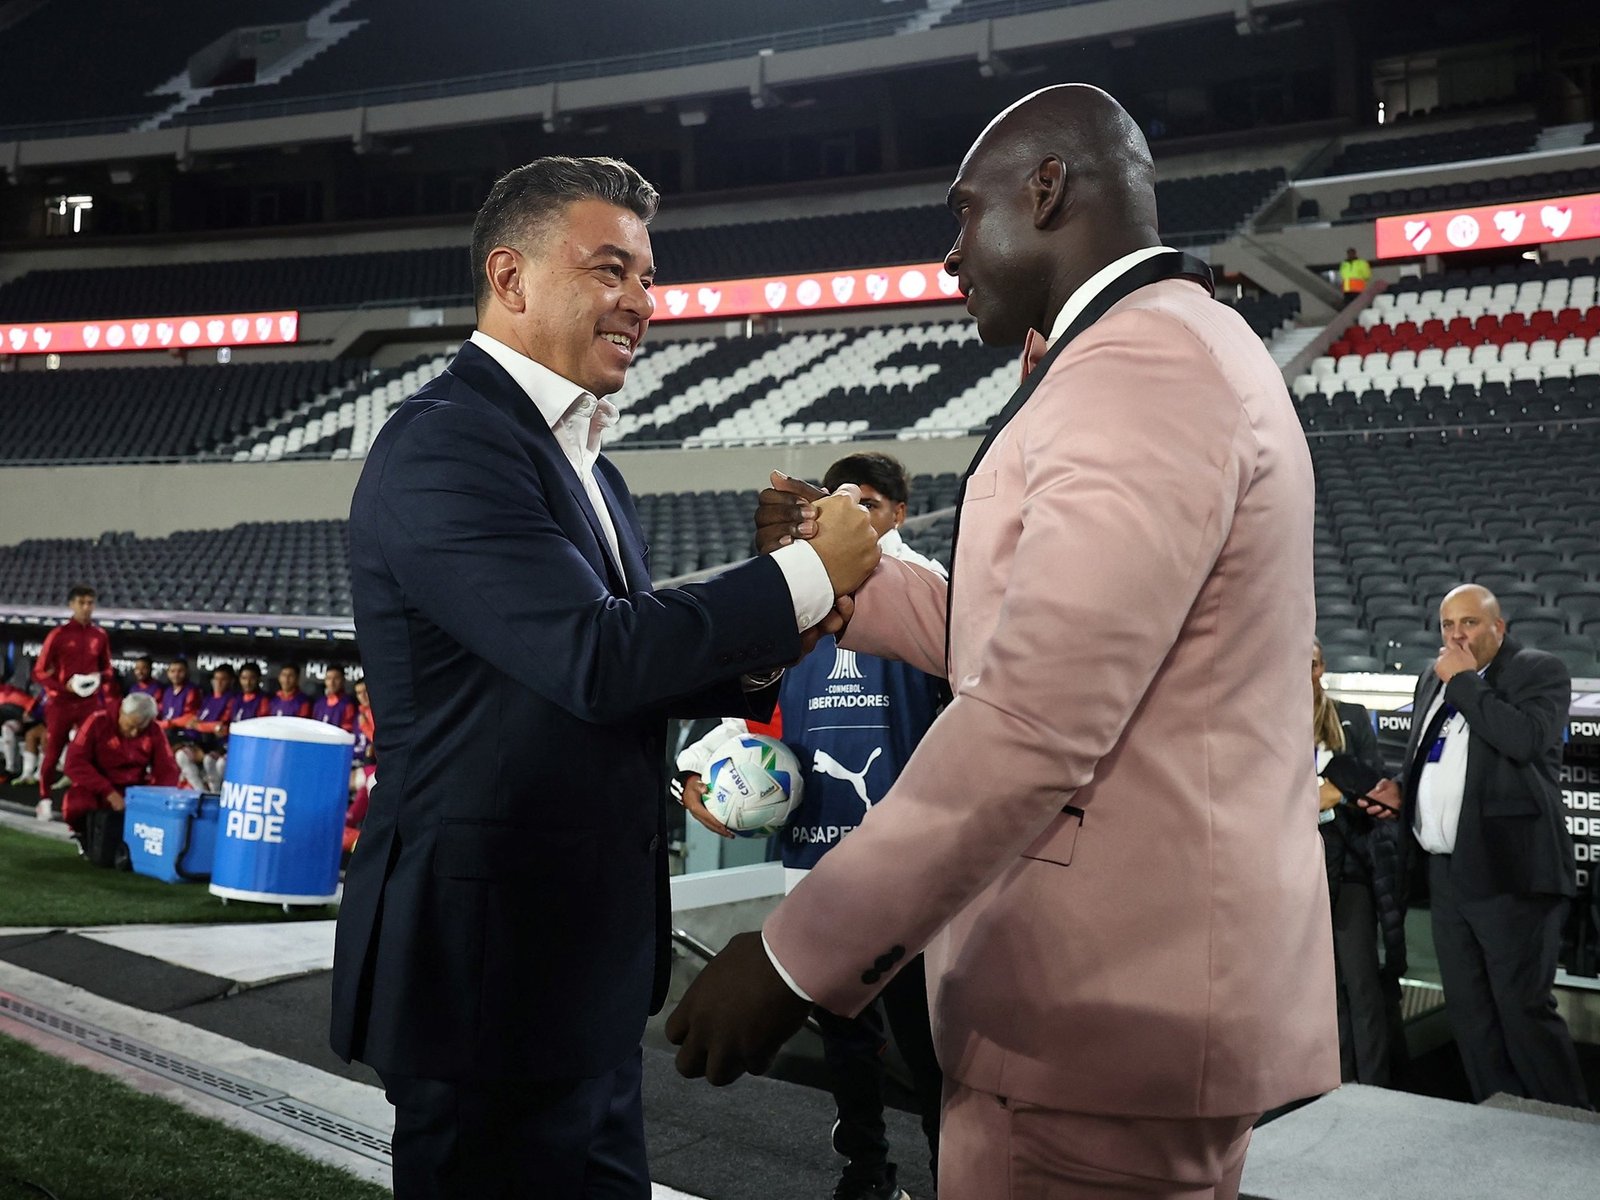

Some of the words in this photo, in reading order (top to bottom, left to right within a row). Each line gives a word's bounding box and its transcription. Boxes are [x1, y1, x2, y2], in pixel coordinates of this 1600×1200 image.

[828, 684, 861, 694] CONMEBOL
[808, 694, 890, 710] LIBERTADORES
[1379, 716, 1412, 730] POW
[226, 810, 285, 843] ADE
[792, 825, 857, 844] PASAPE
